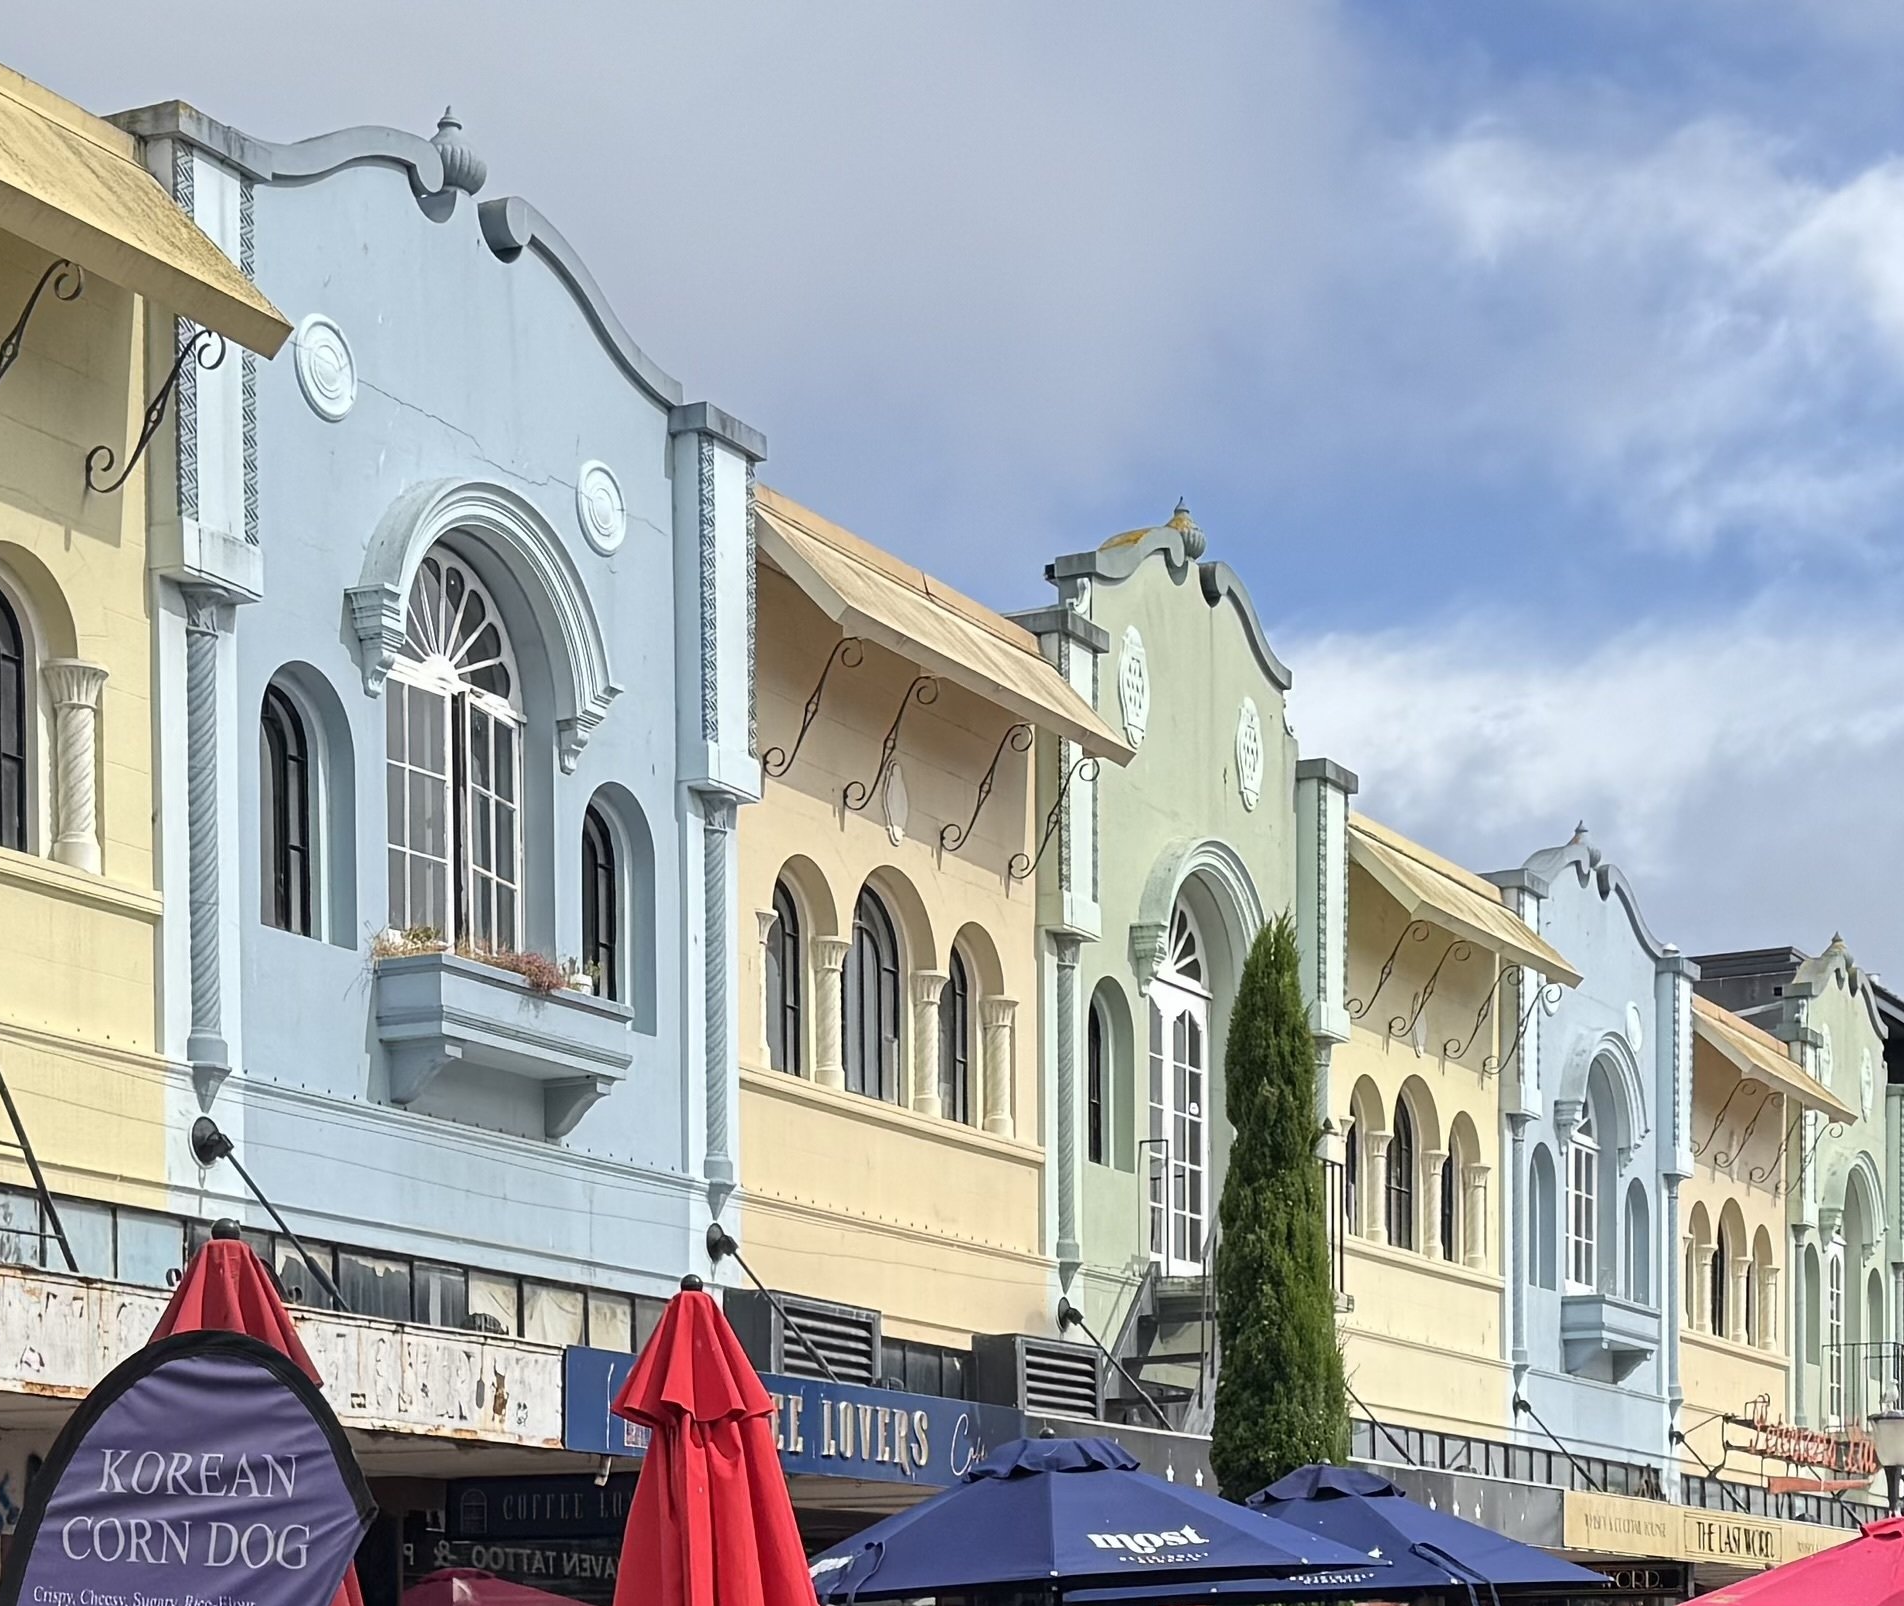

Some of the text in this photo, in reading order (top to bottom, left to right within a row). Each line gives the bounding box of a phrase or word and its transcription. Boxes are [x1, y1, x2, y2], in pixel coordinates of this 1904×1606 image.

[820, 1399, 930, 1477] LOVERS
[95, 1448, 300, 1499] KOREAN
[61, 1515, 312, 1570] CORN DOG
[1696, 1521, 1715, 1553] THE
[1718, 1524, 1742, 1555] LAST
